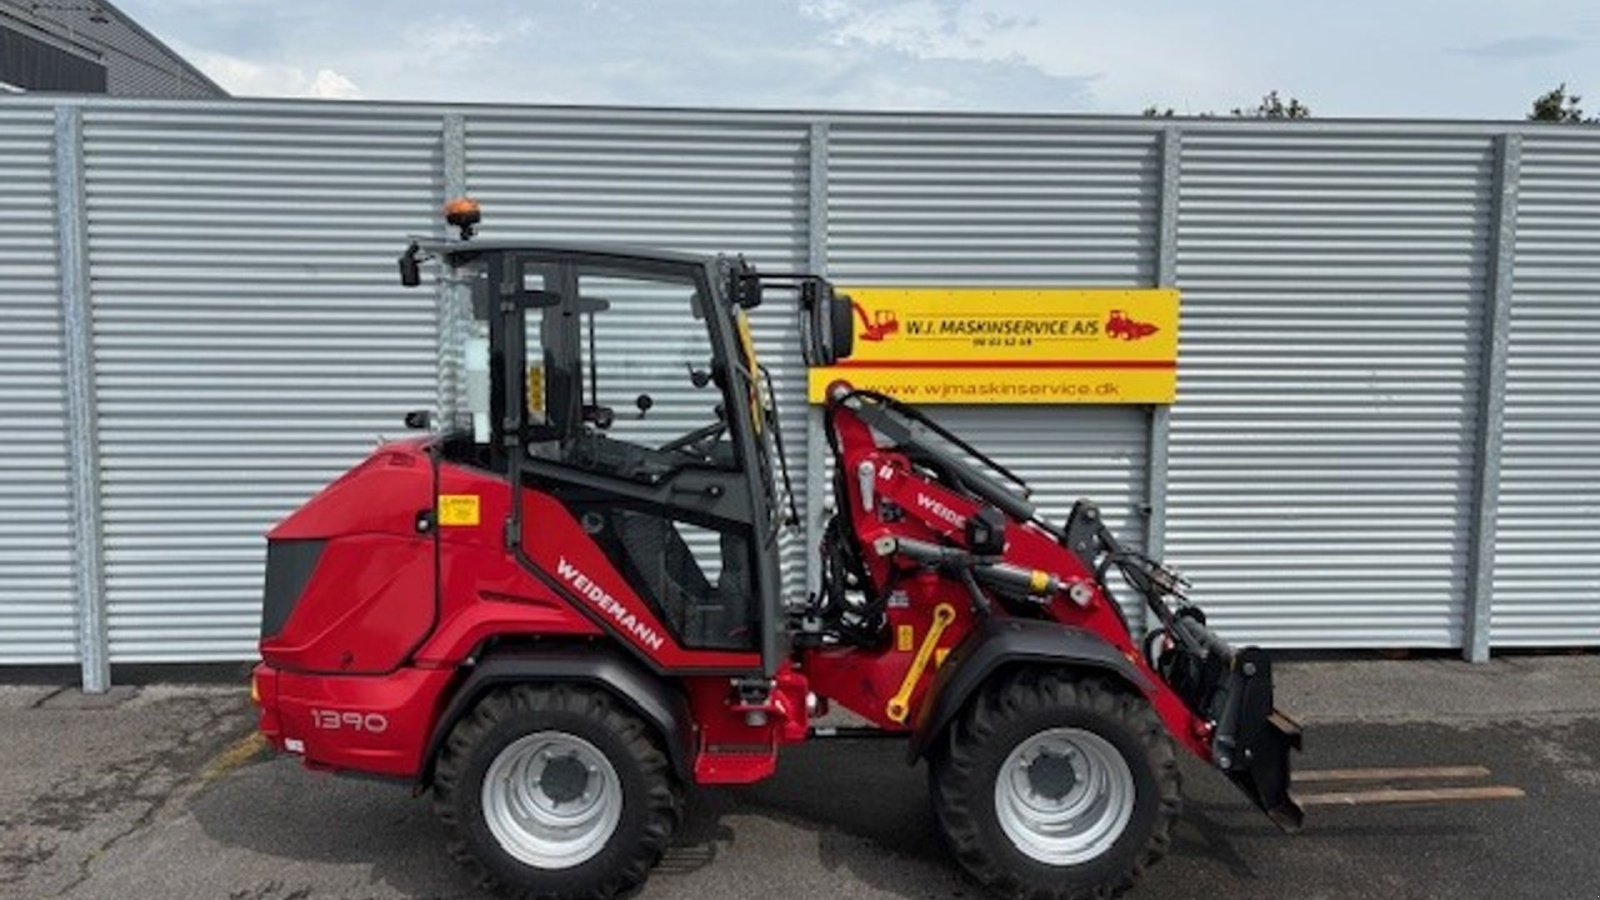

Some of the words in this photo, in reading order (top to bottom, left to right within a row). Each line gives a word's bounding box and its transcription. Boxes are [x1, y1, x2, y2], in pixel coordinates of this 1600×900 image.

[938, 319, 1069, 336] MASKINSERVICE
[1071, 319, 1100, 335] A/S
[557, 555, 664, 650] WEIDEMANN
[310, 708, 389, 733] 1390
